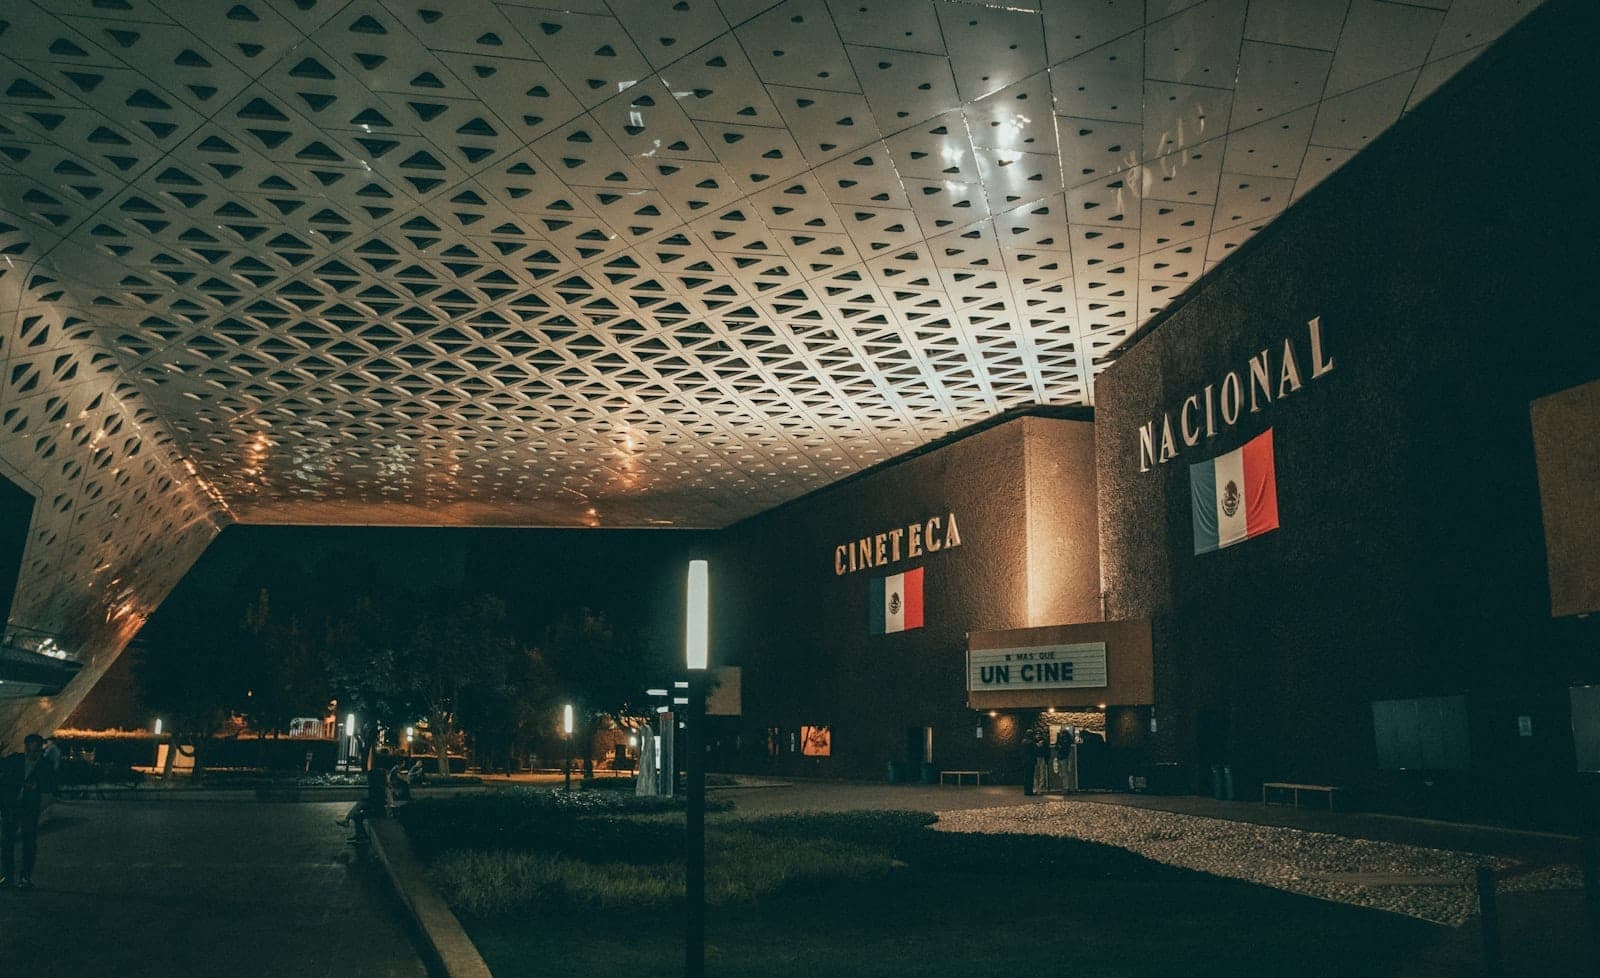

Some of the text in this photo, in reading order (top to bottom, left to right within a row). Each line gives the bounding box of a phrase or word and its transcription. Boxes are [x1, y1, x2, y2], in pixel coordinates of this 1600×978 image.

[1138, 316, 1335, 473] NACIONAL
[834, 512, 962, 576] CINETECA
[981, 661, 1073, 684] UN CINE
[1039, 651, 1056, 660] QUE
